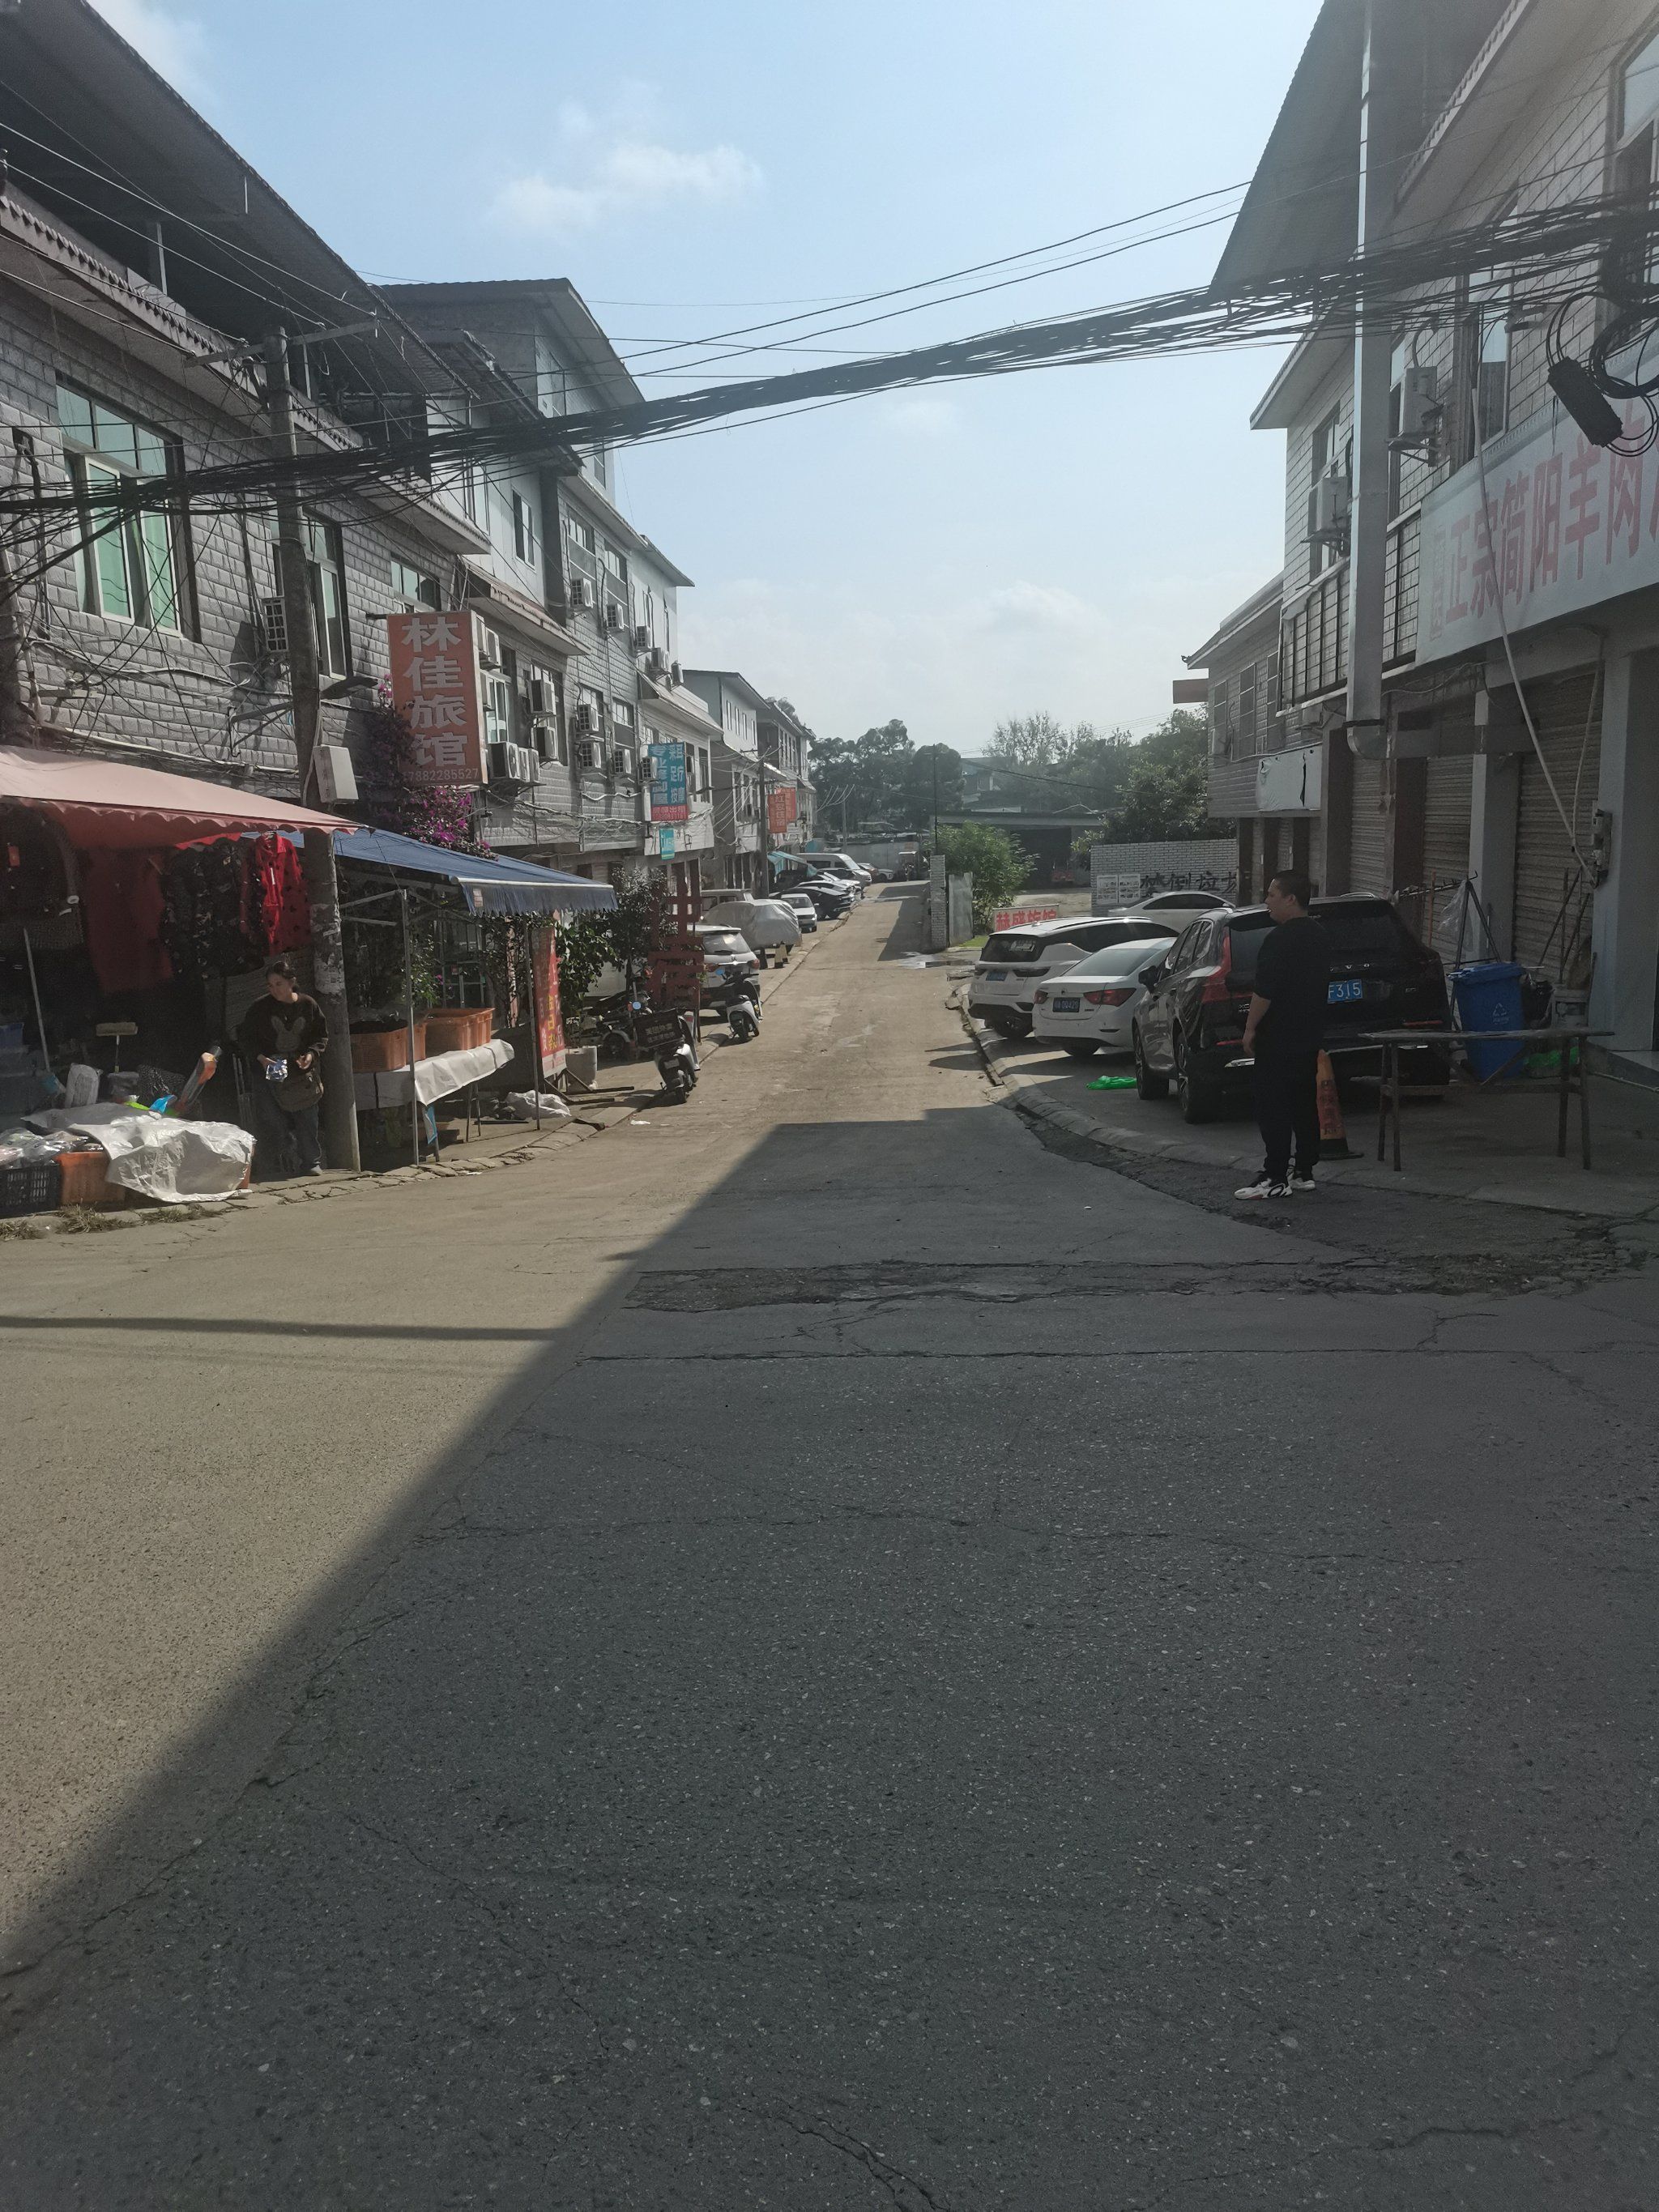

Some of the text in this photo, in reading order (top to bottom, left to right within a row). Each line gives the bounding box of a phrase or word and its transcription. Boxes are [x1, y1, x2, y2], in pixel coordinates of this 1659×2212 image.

[1446, 398, 1659, 624] 正宗简阳羊肉
[402, 616, 467, 767] 林佳旅馆
